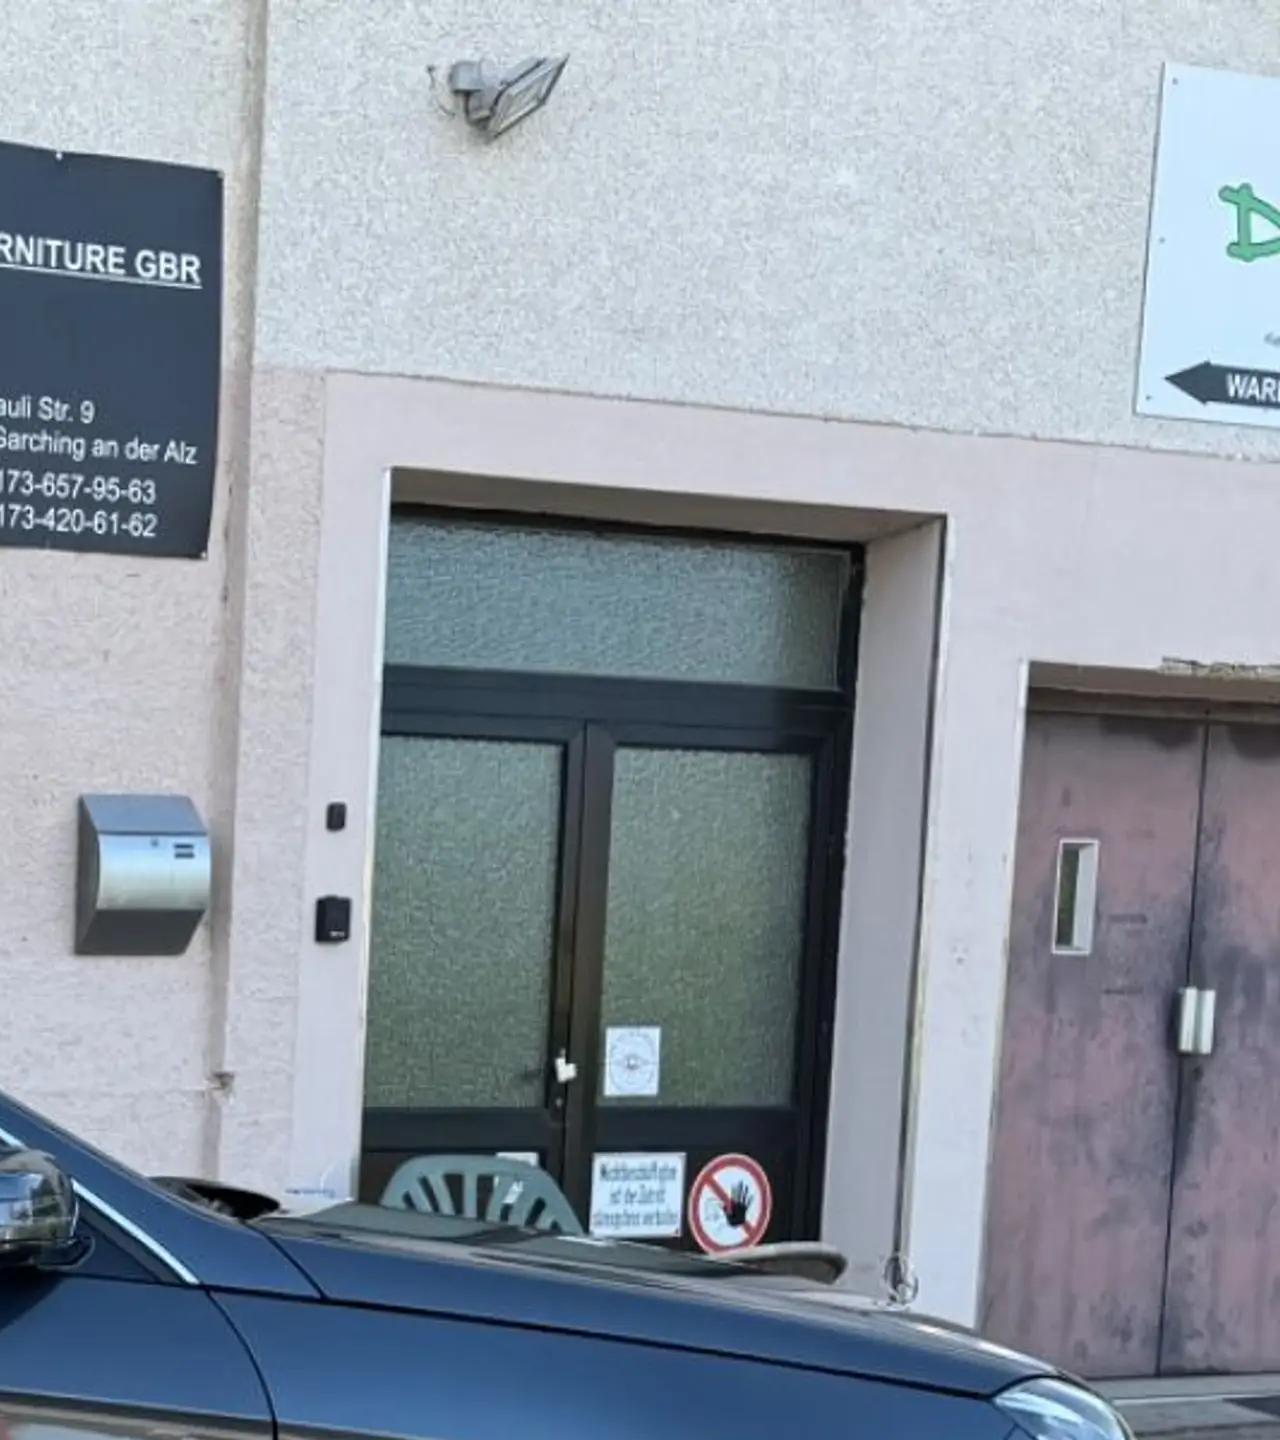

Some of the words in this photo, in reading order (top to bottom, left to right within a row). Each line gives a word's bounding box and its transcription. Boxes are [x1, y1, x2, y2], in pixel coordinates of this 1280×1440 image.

[135, 249, 202, 284] GBR
[1226, 373, 1280, 403] WAR
[37, 396, 74, 423] Str.
[79, 401, 96, 424] 9
[91, 437, 119, 457] an
[125, 433, 159, 460] der
[163, 438, 197, 465] Alz
